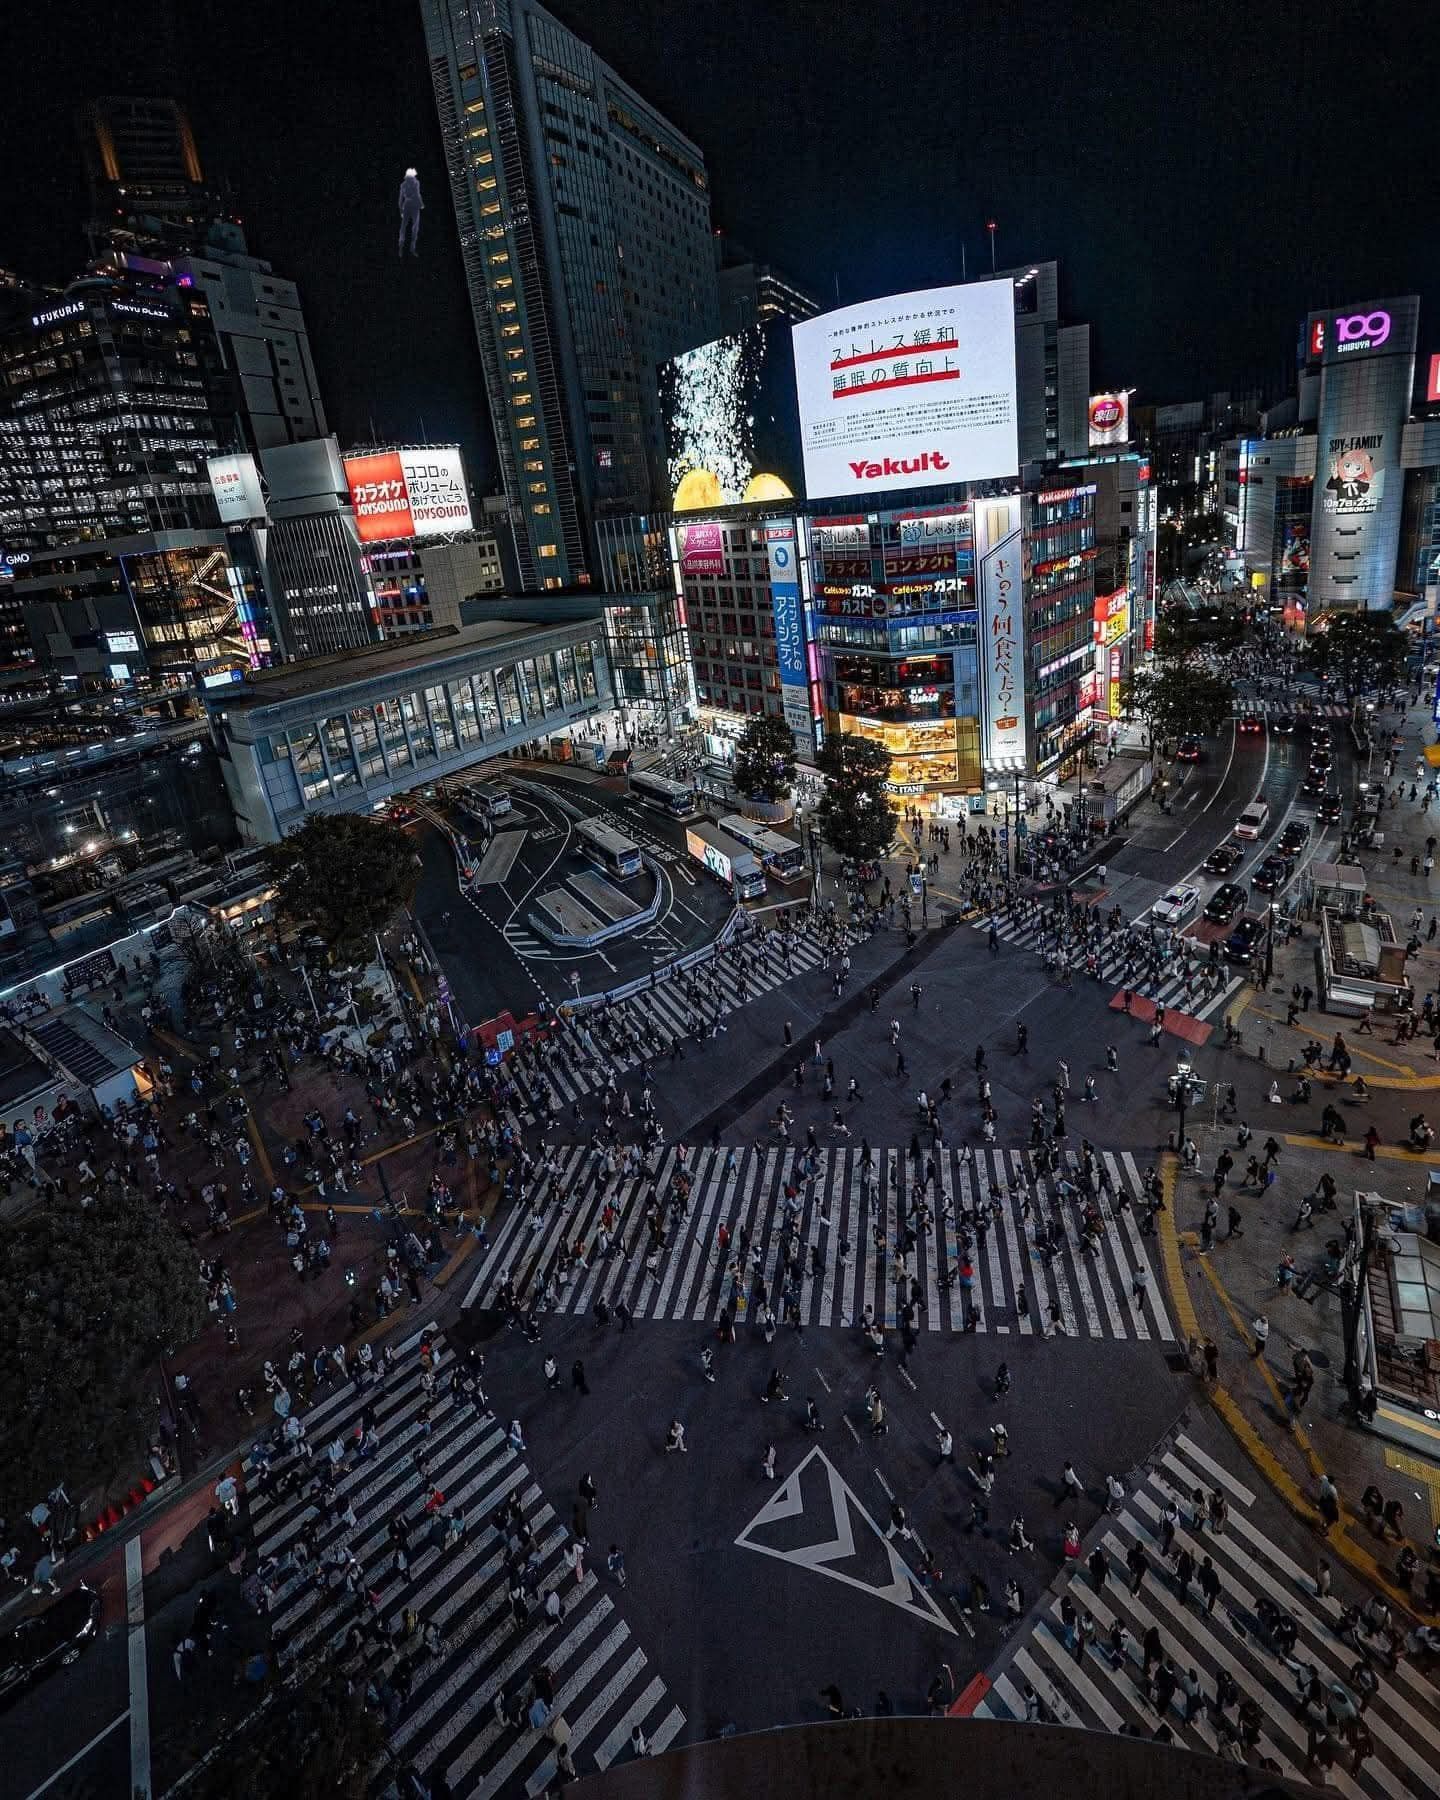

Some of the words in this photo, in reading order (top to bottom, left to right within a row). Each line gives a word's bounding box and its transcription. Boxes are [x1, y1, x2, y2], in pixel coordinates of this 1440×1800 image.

[41, 301, 85, 323] FUKURAS
[112, 302, 141, 313] TOKYU
[142, 307, 169, 318] PLAZA
[1336, 311, 1391, 347] 109
[832, 326, 955, 363] ストレス緩和
[1337, 340, 1370, 353] SHIBUYA
[832, 355, 956, 391] 睡眠の質向上
[405, 465, 449, 479] ココロの
[848, 451, 950, 479] Yakult
[353, 480, 404, 503] カラオケ
[409, 480, 463, 494] ボリューム、
[358, 498, 408, 516] JOYSOUND
[411, 493, 466, 506] あげていこう。
[413, 505, 468, 520] JOYSOUND
[6, 553, 30, 565] GMO
[886, 555, 954, 575] コンタクト
[851, 584, 877, 598] ガスト
[934, 578, 968, 593] ガスト
[842, 598, 871, 615] ガスト
[775, 596, 793, 671] アイシティ
[788, 596, 803, 672] コンタクトの
